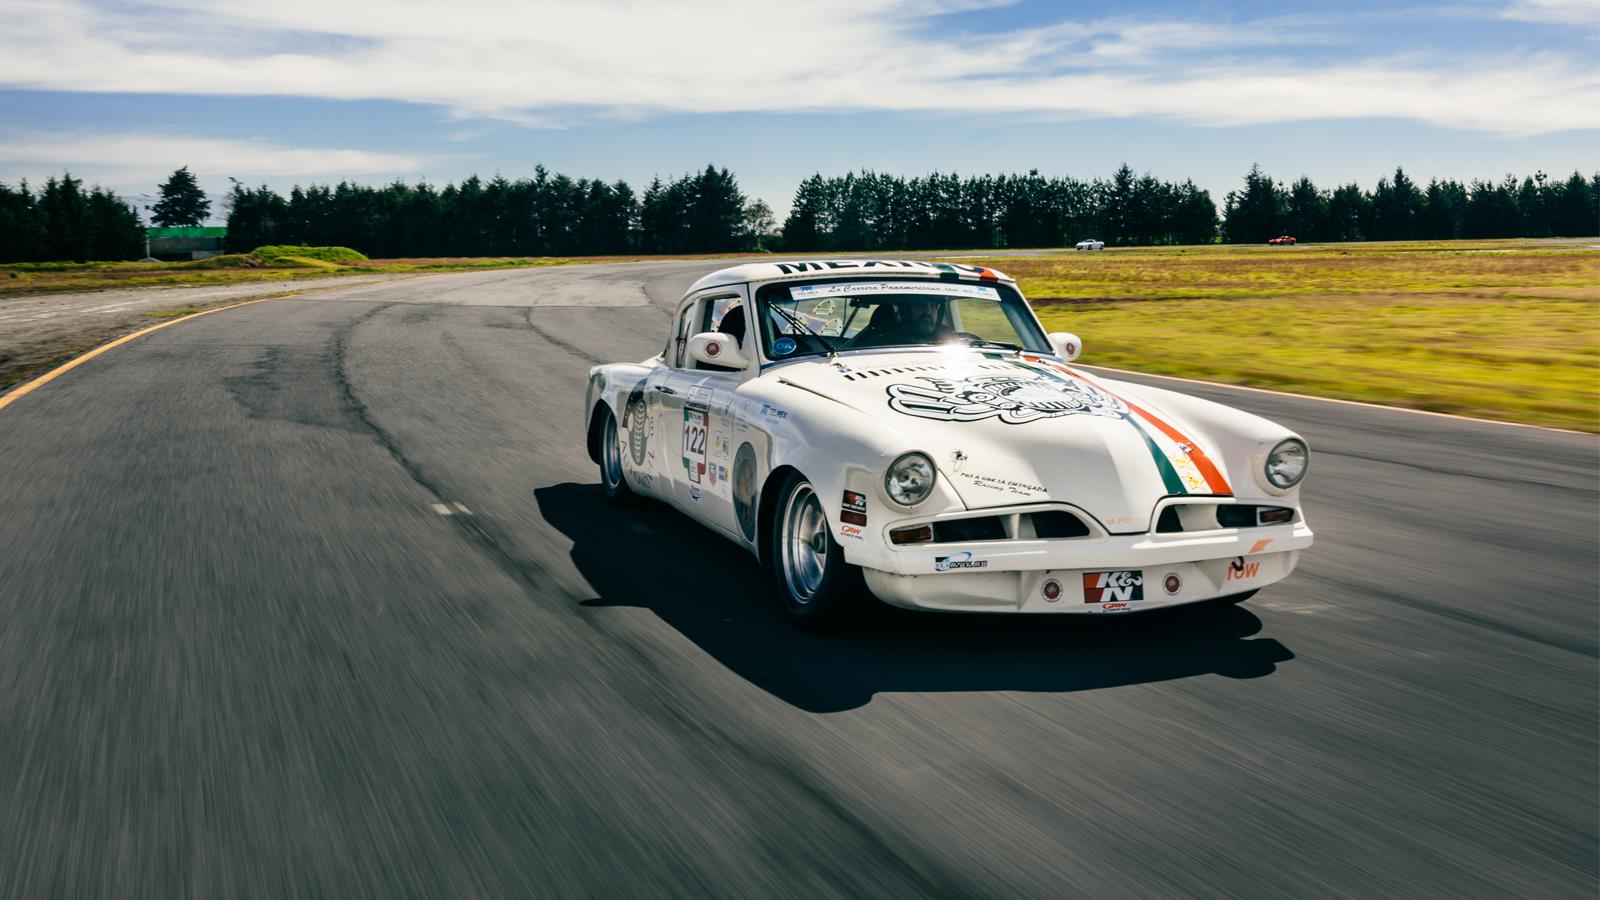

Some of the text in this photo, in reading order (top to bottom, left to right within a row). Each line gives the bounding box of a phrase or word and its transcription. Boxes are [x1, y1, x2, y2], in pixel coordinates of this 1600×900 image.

[843, 284, 878, 292] Carrera
[879, 283, 940, 291] Panamericana
[776, 342, 792, 350] OK
[684, 426, 705, 455] 122
[973, 480, 1031, 496] Racing Team
[1007, 481, 1048, 493] CHINGADA
